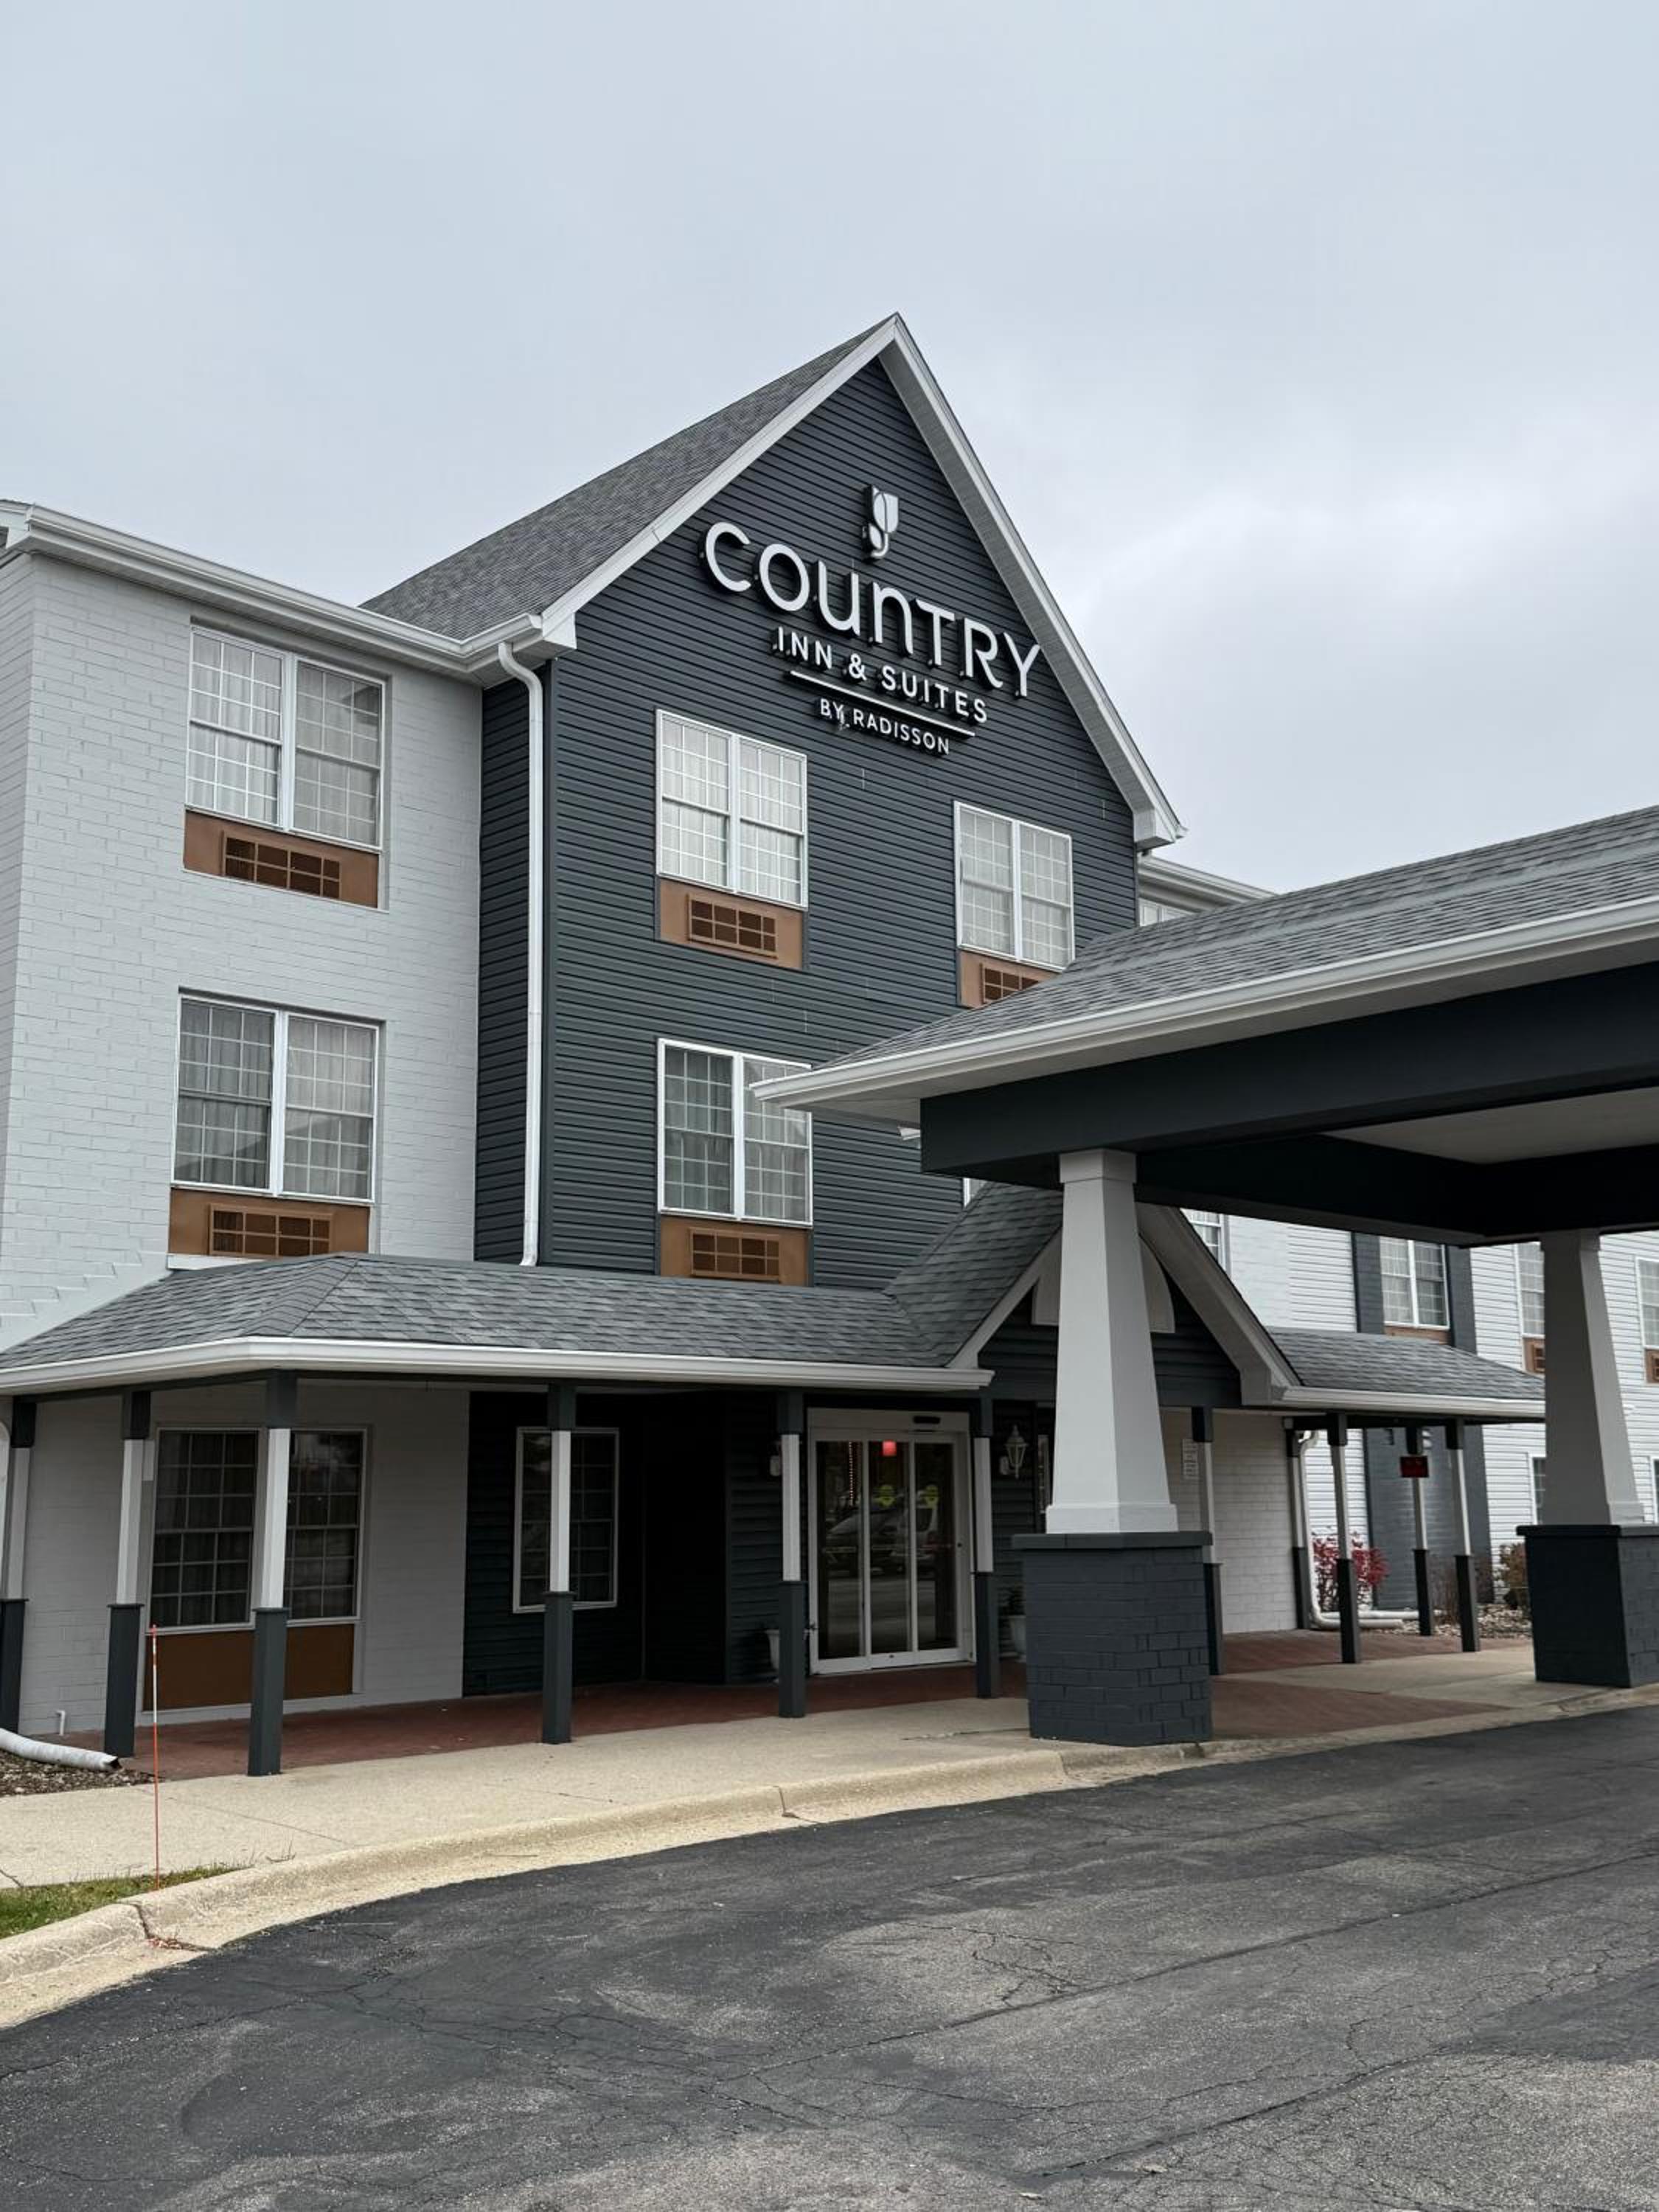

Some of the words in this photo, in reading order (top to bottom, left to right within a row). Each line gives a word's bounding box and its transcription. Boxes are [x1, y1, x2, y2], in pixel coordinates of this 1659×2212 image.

[777, 626, 833, 669] INN
[848, 653, 867, 681] &
[881, 665, 988, 723] SUITES
[820, 698, 844, 723] BY
[853, 709, 950, 755] RADISSON
